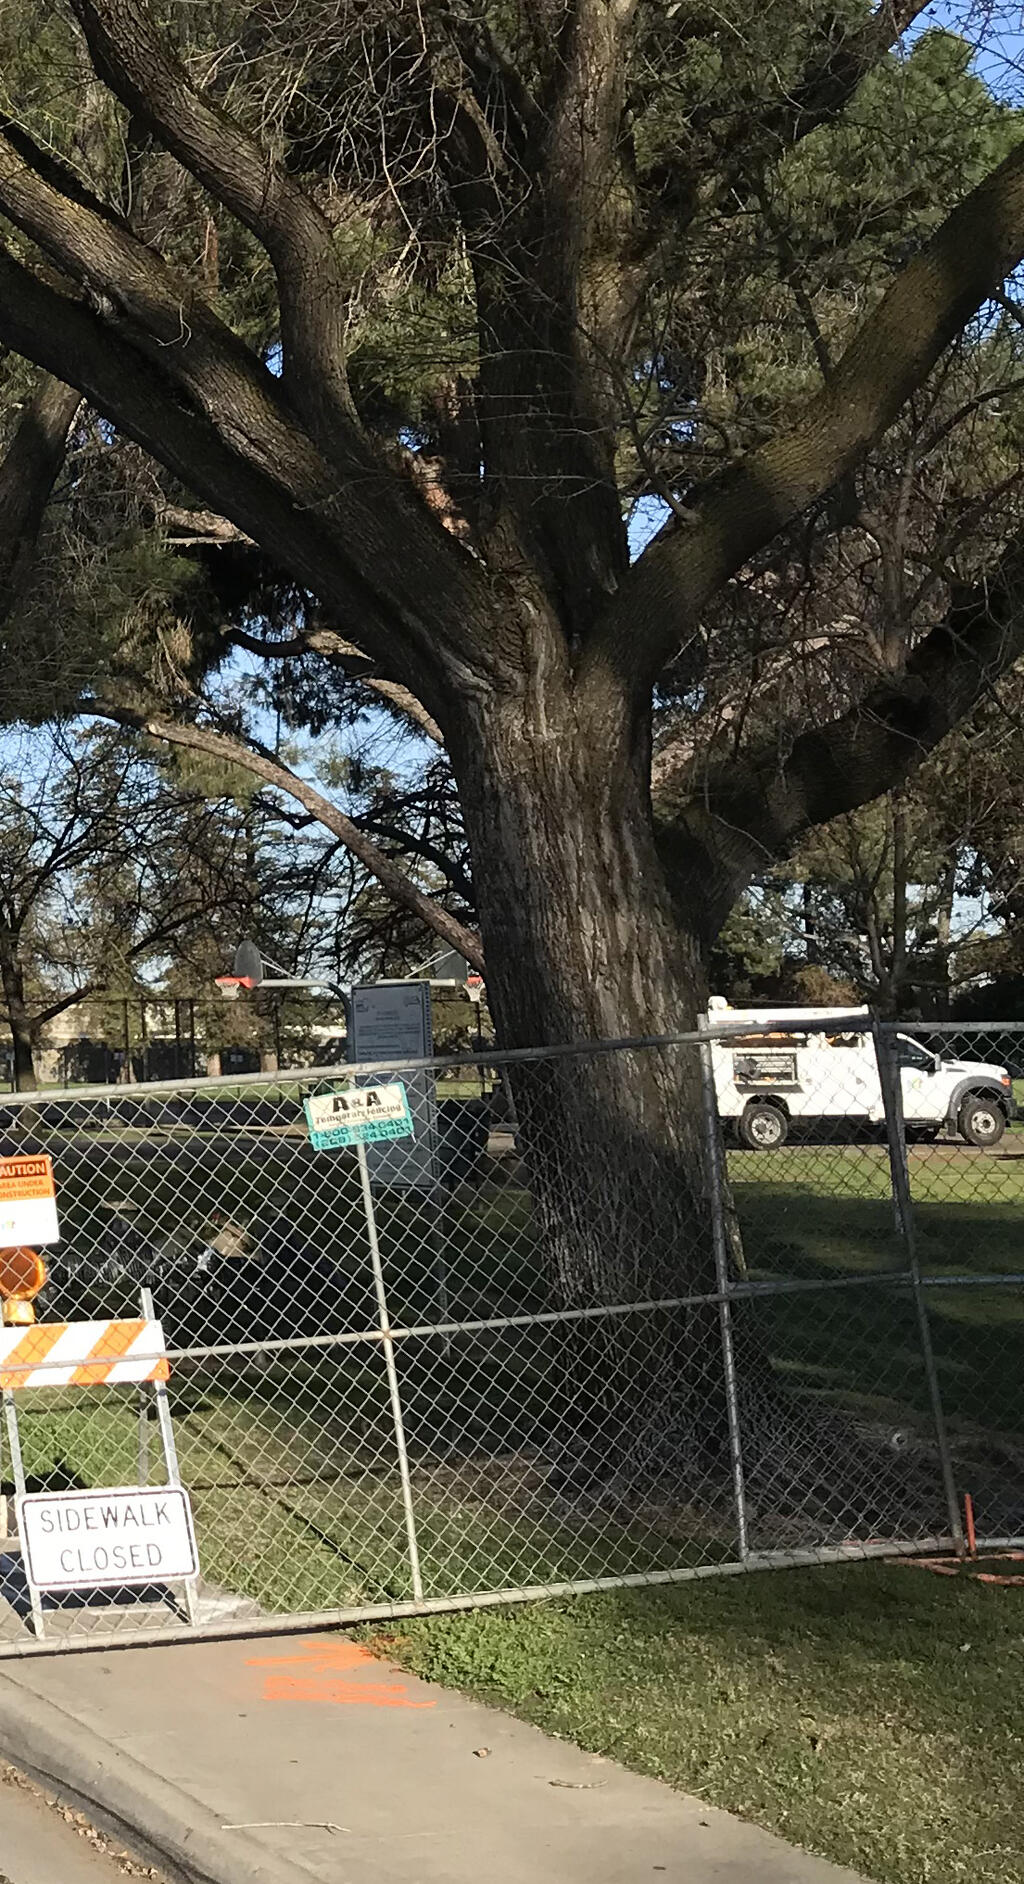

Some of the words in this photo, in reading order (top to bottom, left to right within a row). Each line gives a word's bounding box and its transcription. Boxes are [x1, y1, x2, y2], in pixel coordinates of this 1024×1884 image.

[18, 1179, 44, 1188] UNDER
[40, 1501, 172, 1533] SIDEWALK
[59, 1542, 163, 1573] CLOSED
